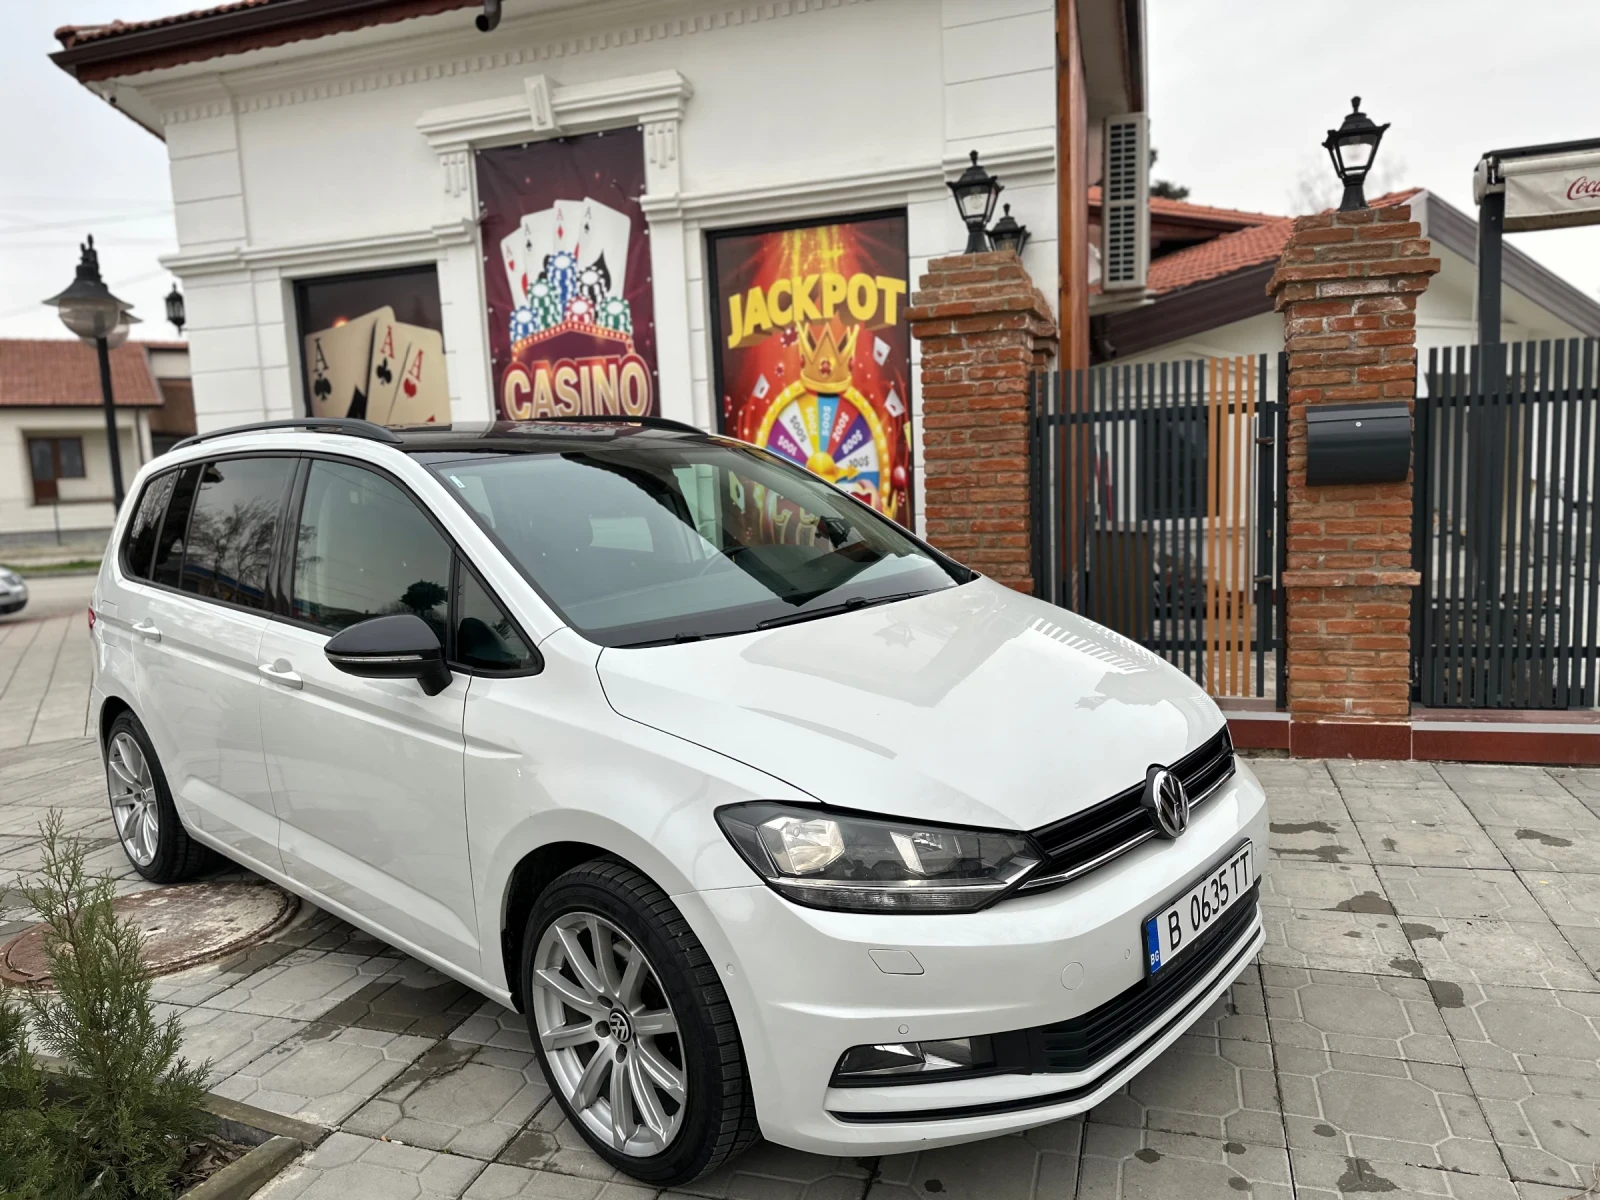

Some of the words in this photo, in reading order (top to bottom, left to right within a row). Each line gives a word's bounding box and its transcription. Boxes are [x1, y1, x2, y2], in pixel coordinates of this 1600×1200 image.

[728, 272, 907, 349] JACKPOT
[313, 338, 329, 373] A
[380, 325, 395, 359] A
[408, 349, 424, 382] A
[504, 355, 650, 420] CASINO
[1168, 910, 1182, 952] B
[1191, 869, 1229, 931] 0635
[1230, 850, 1250, 895] TT
[1150, 950, 1160, 966] BG
